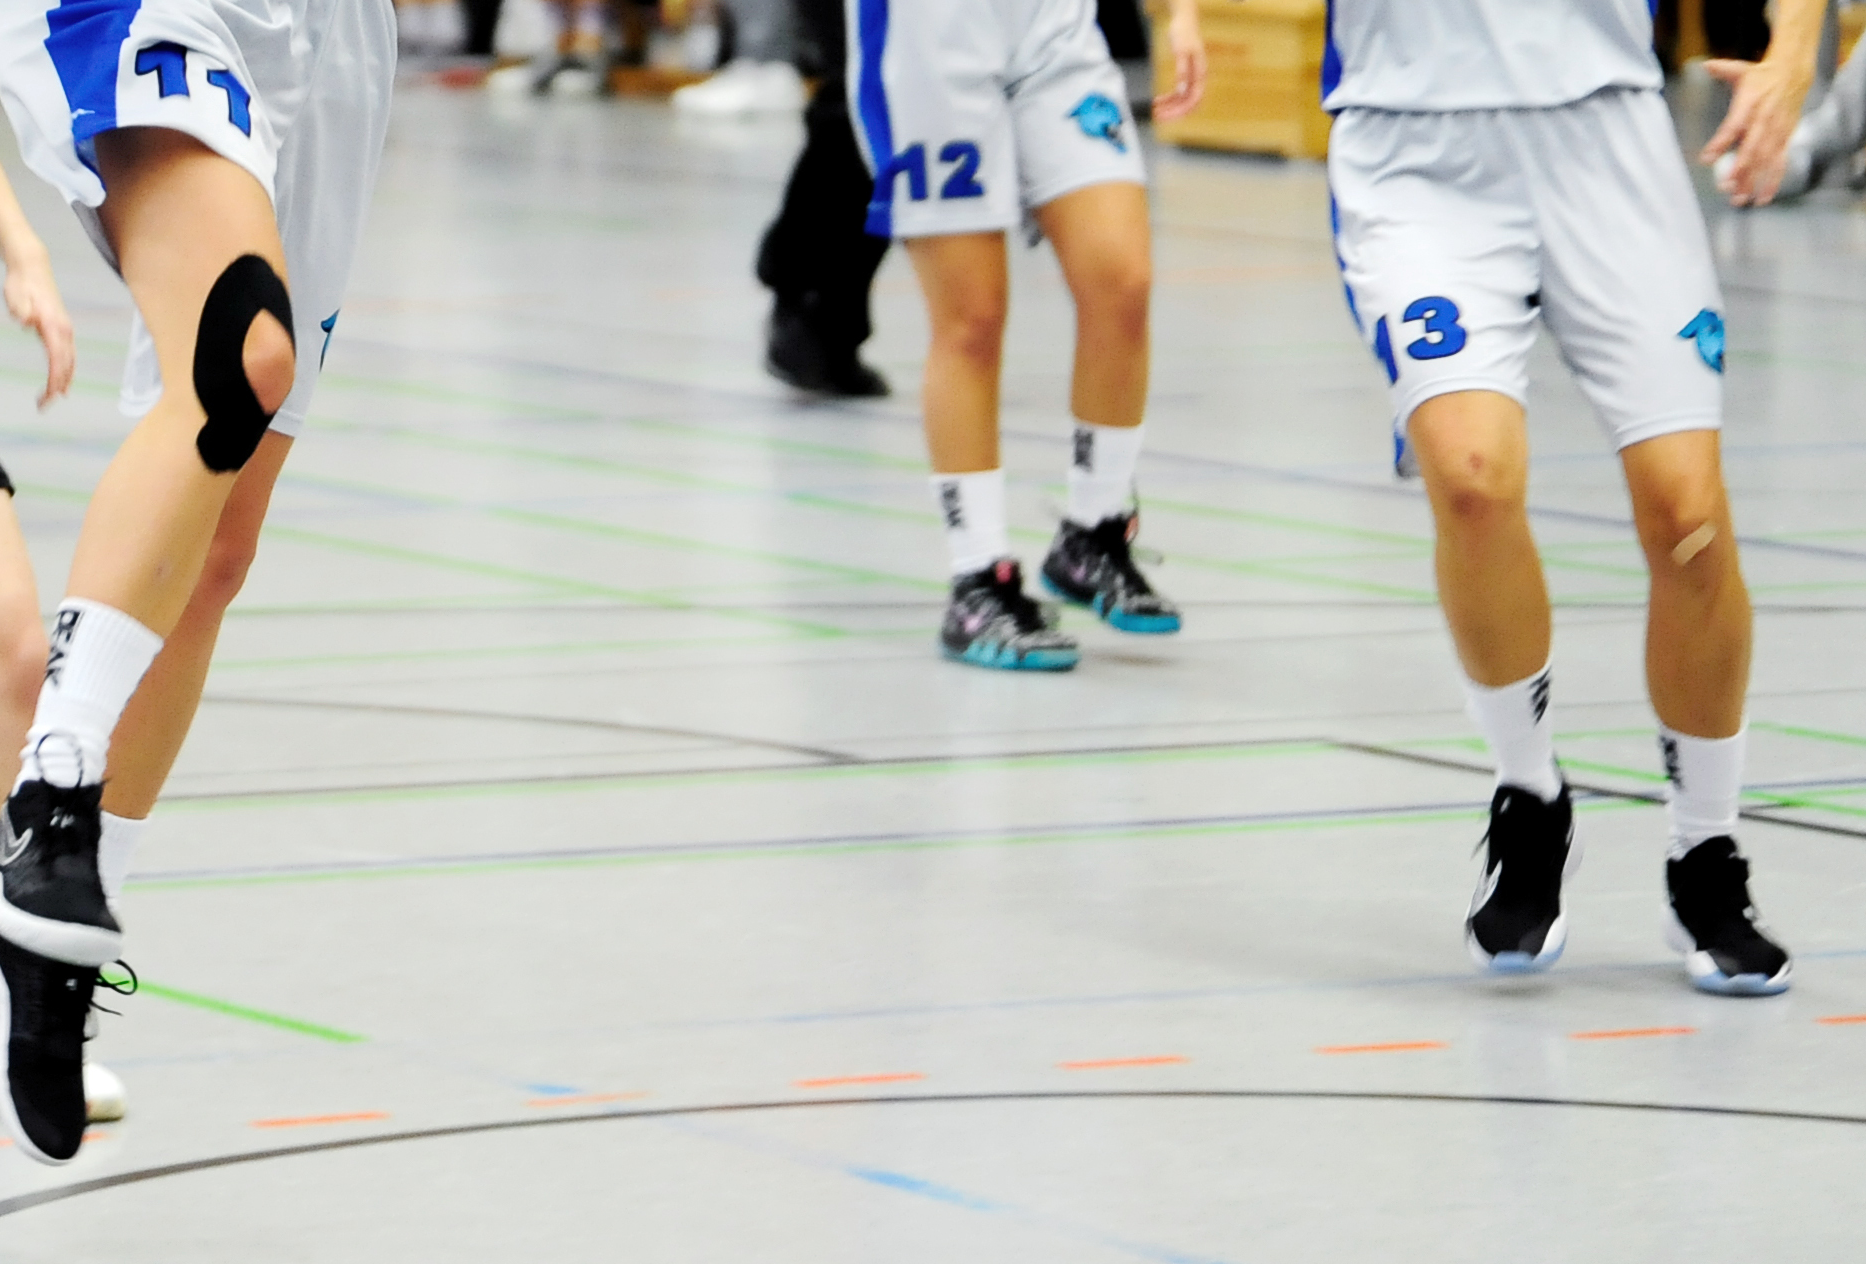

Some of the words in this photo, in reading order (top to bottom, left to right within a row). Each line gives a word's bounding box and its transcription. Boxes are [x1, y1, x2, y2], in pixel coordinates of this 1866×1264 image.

[135, 40, 252, 138] 11
[886, 140, 984, 201] 12
[1374, 295, 1468, 385] 13
